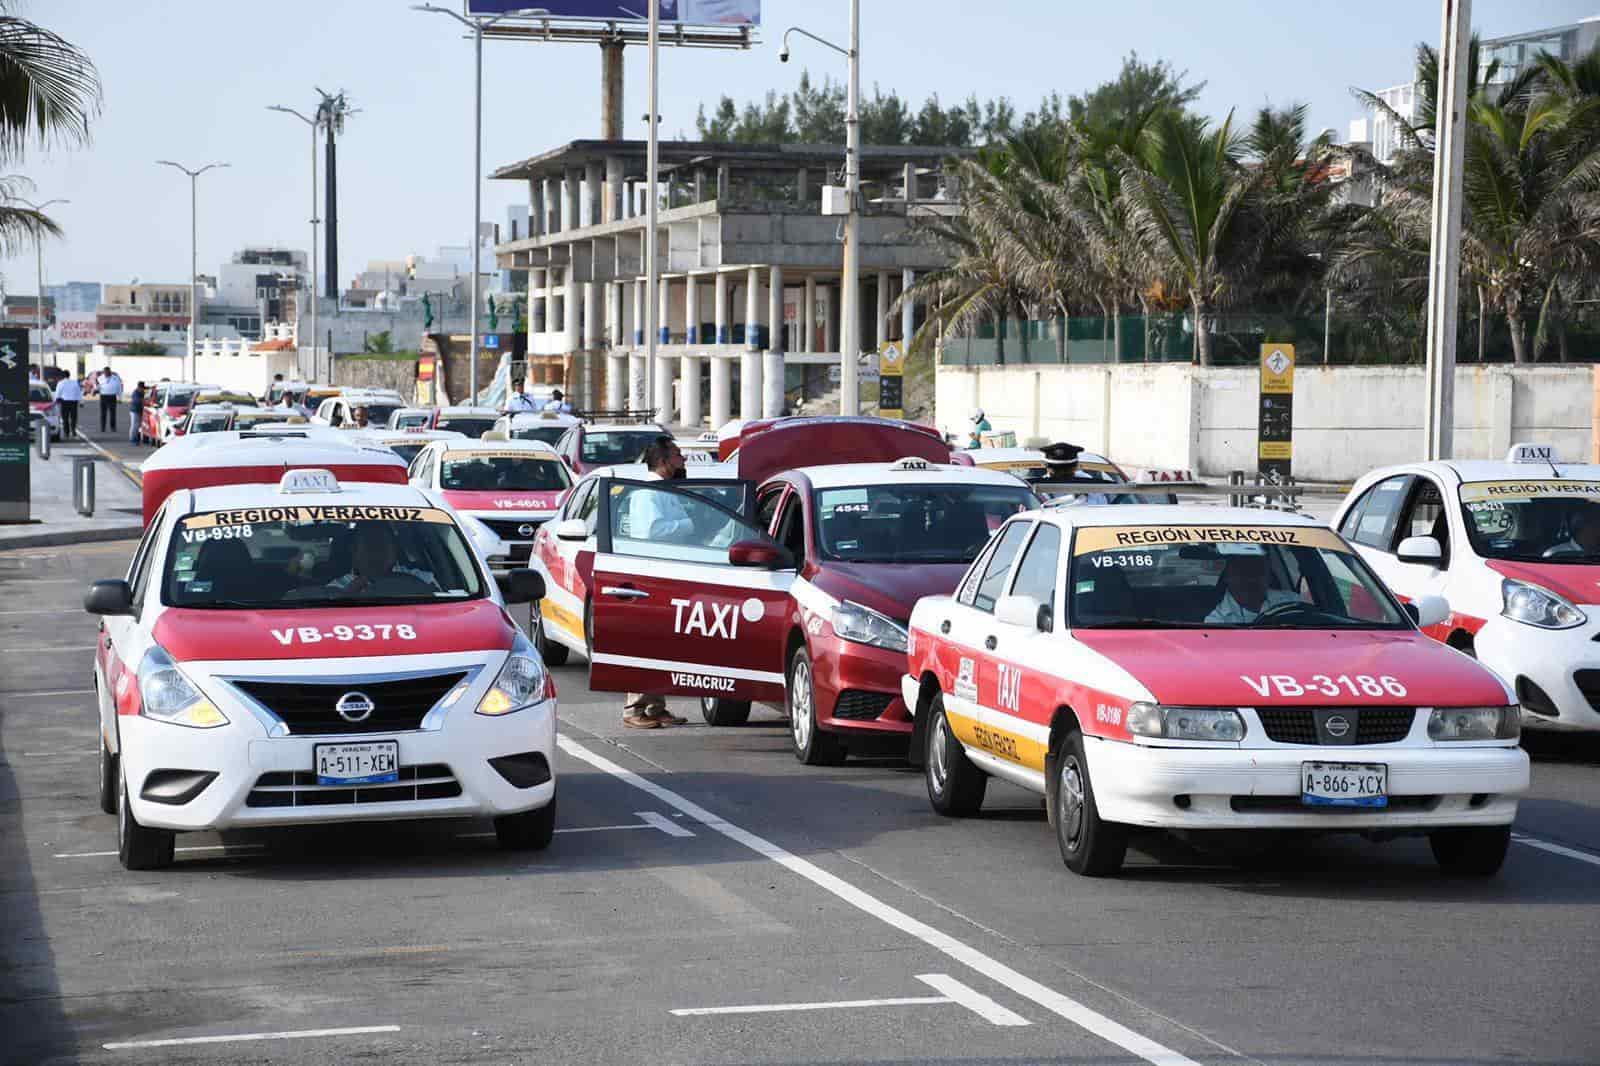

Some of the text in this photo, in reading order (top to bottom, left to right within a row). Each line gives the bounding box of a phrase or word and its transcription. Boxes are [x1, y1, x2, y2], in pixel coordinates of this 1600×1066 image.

[1521, 447, 1551, 459] TAXI
[902, 462, 926, 470] TAXI
[292, 475, 328, 488] TAXI
[1148, 470, 1193, 482] TAXI
[1488, 485, 1549, 495] REGION
[215, 506, 424, 525] REGION VERACRUZ
[181, 525, 253, 543] VB-9378
[1116, 527, 1300, 545] REGIÓN VERACRUZ
[1091, 554, 1153, 568] VB-3186
[671, 598, 740, 640] TAXI
[271, 624, 417, 646] VB-9378
[671, 672, 736, 692] VERACRUZ
[997, 663, 1021, 713] TAXI
[1239, 674, 1408, 697] VB-3186
[1306, 773, 1383, 794] A-866-XCX
